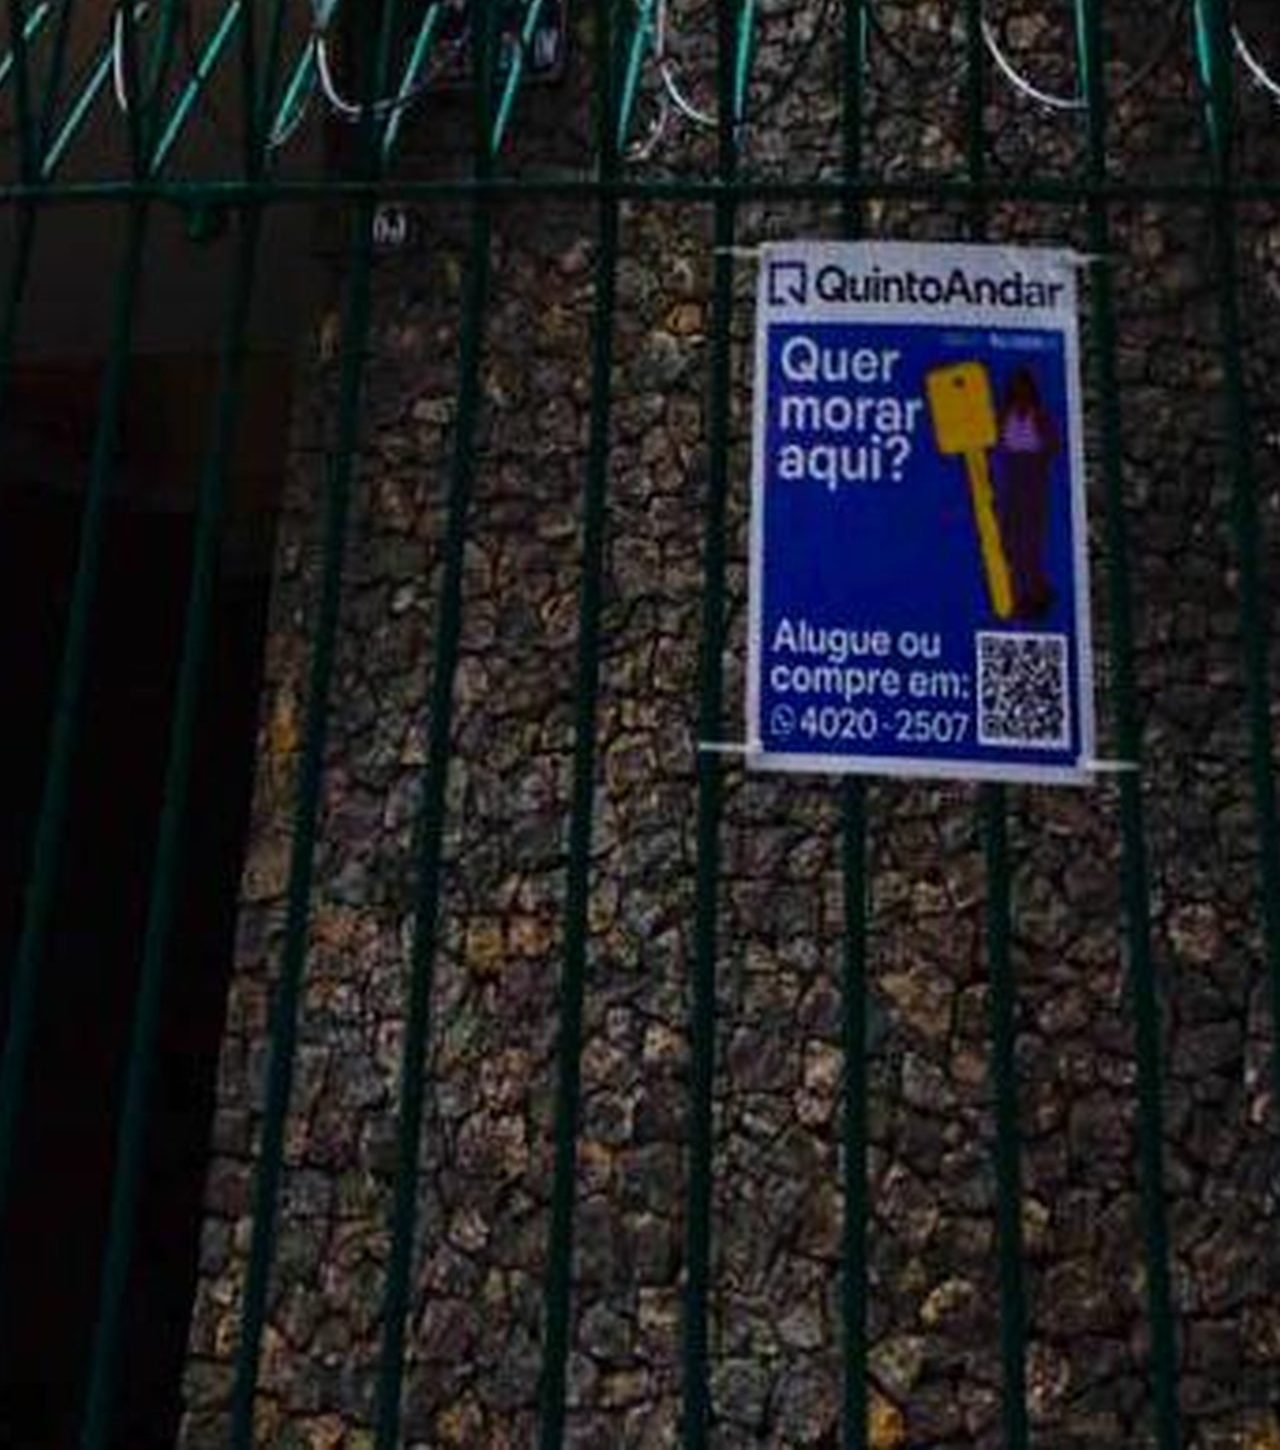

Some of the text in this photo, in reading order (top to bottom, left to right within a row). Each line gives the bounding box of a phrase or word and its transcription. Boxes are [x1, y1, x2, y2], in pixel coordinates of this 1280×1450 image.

[816, 265, 1064, 308] QuintoAndar
[781, 336, 900, 383] Quer
[780, 396, 923, 432] morar
[778, 435, 912, 492] aqui?
[773, 618, 941, 663] Alugue ou
[770, 665, 970, 702] compre em:
